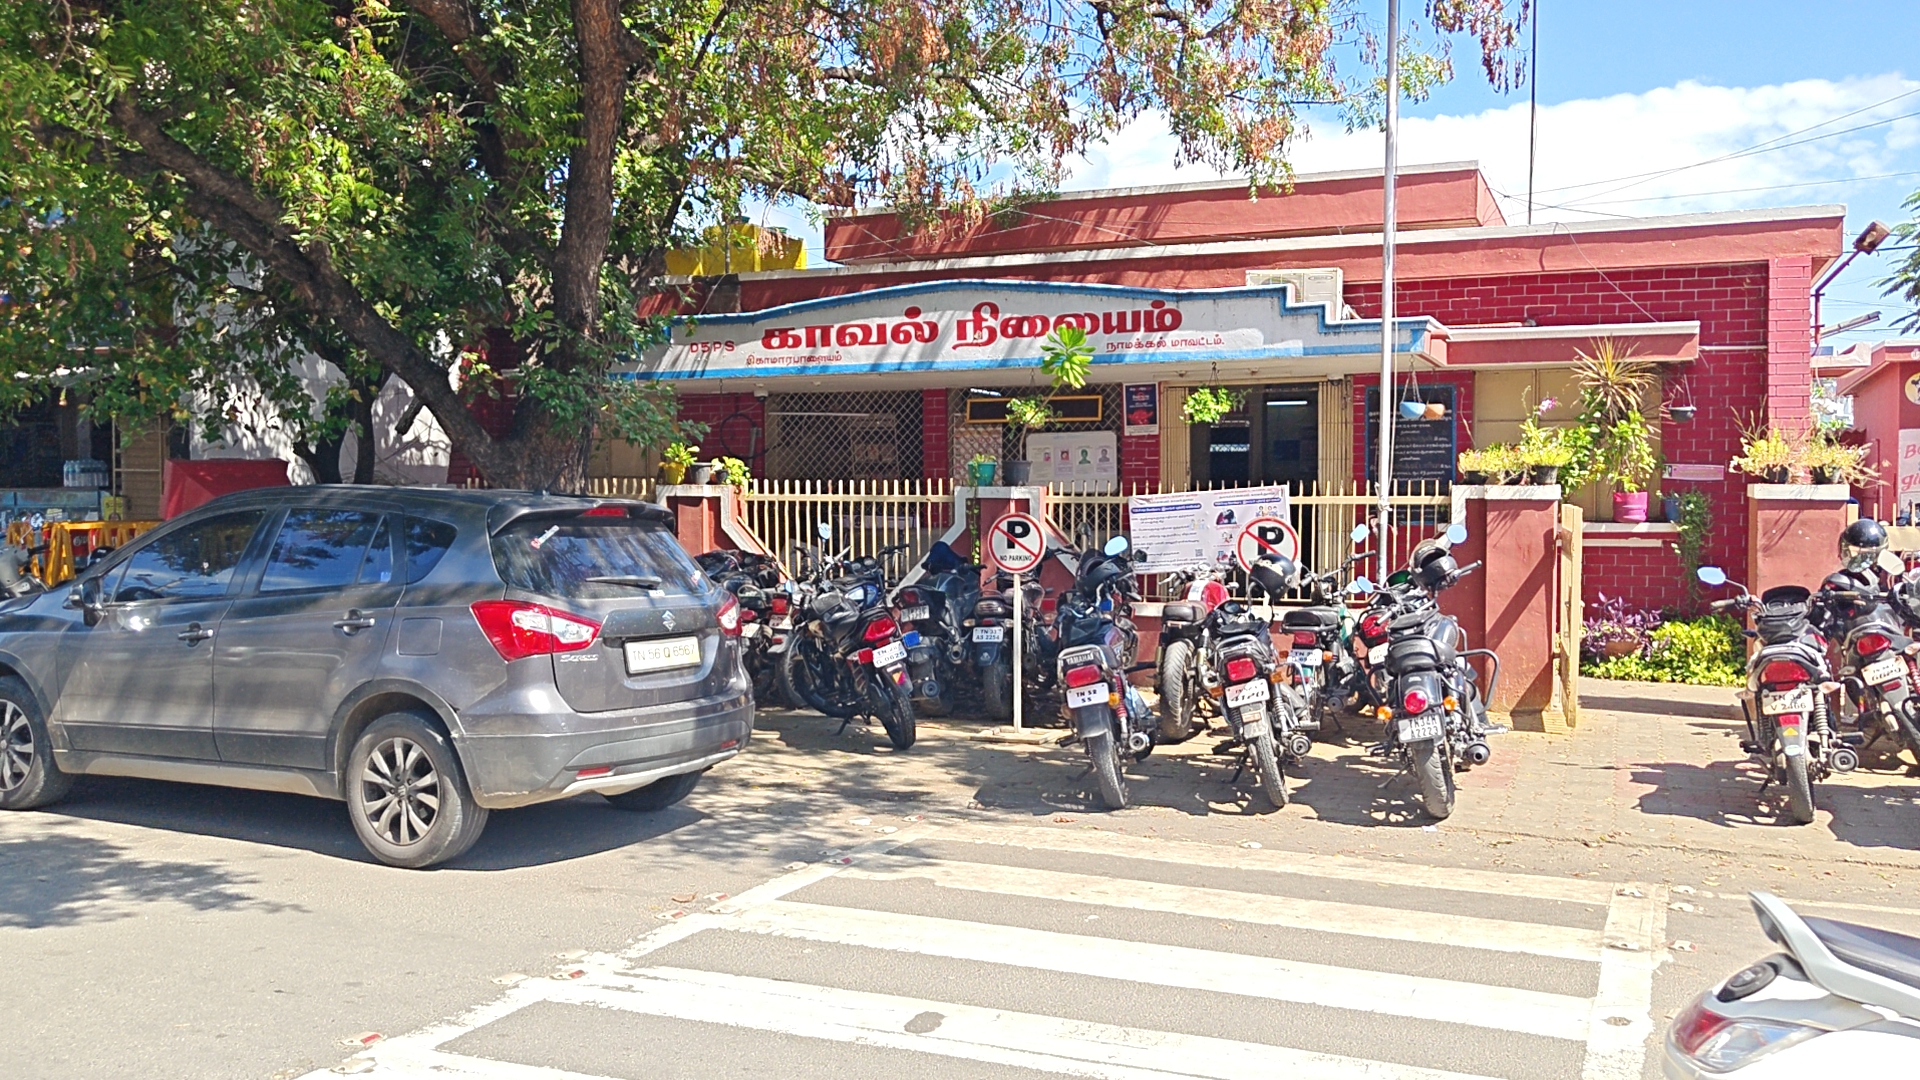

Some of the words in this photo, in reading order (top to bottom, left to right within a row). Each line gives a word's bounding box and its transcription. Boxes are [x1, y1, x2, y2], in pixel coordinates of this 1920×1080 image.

[760, 305, 940, 350] காவல்
[950, 299, 1184, 350] நிலையம்
[1105, 336, 1167, 353] நாமக்கல்
[1007, 520, 1031, 549] P
[1008, 554, 1033, 562] PARKING
[632, 649, 646, 661] TN
[648, 648, 661, 660] 56
[673, 644, 696, 657] 6567
[1065, 652, 1095, 666] YAMAHA
